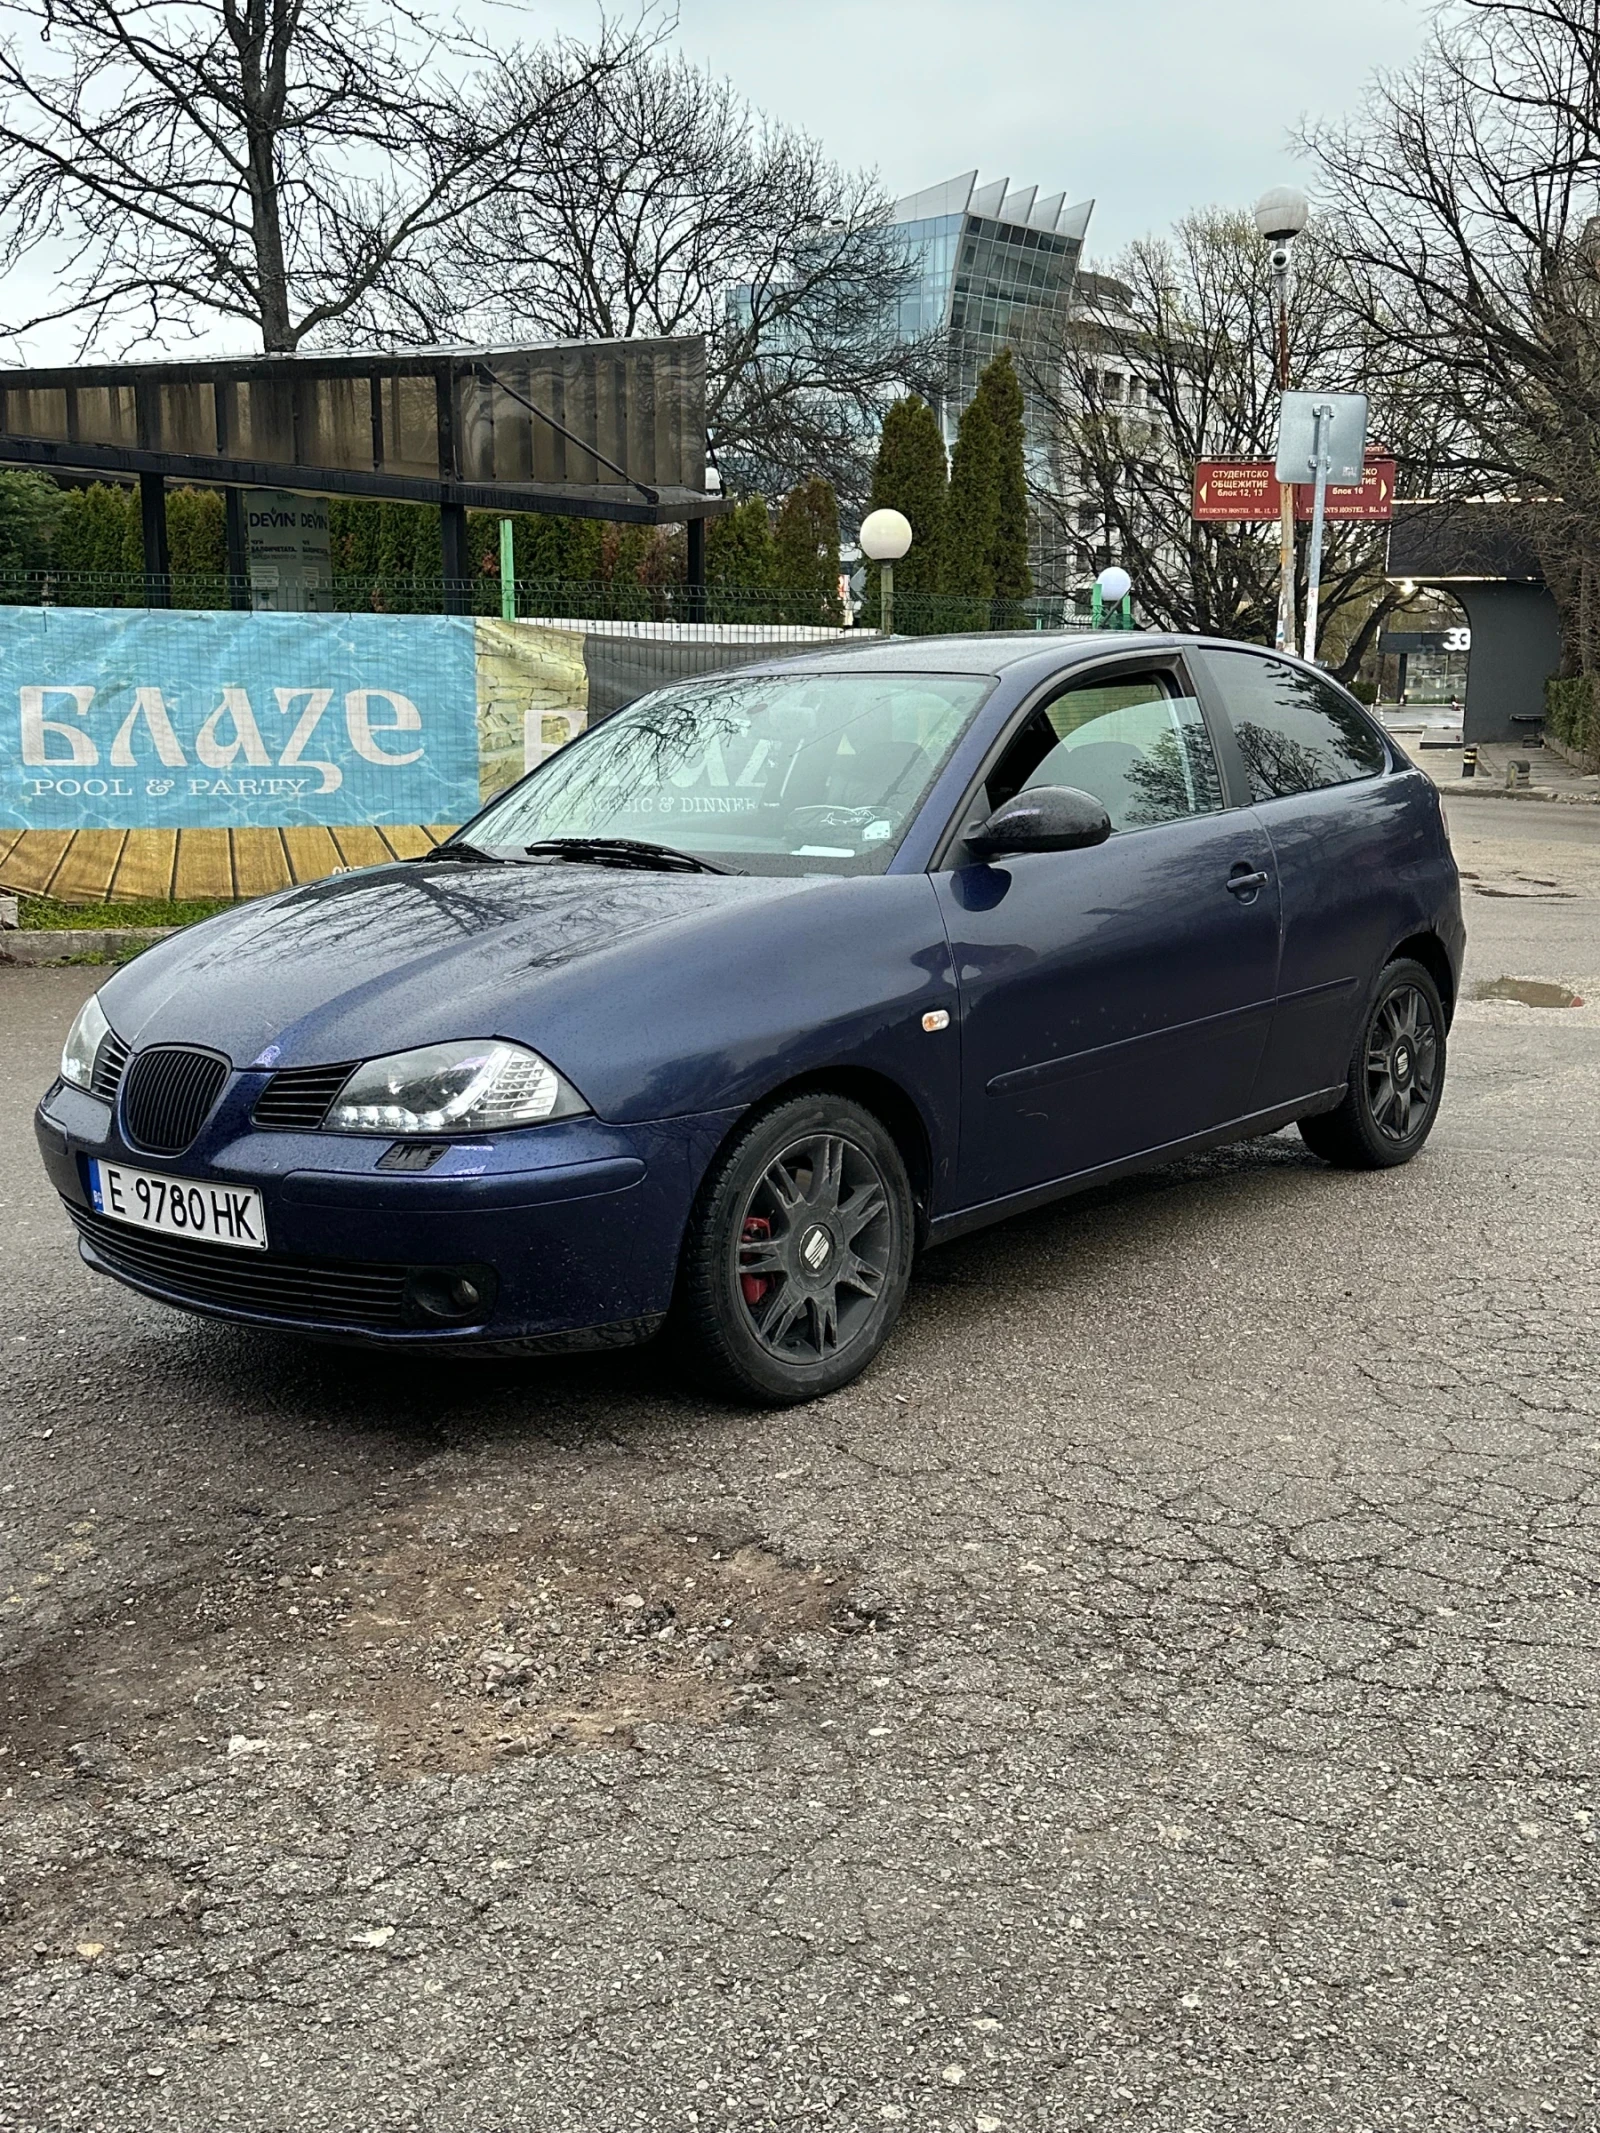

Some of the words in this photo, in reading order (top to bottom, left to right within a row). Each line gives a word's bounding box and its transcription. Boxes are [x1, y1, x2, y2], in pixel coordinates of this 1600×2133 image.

[1212, 470, 1269, 479] СТУДЕНТСКО
[1211, 480, 1269, 489] ОБЩЕЖИТИЕ
[1332, 487, 1352, 495] блок
[1354, 487, 1363, 495] 16
[1217, 489, 1237, 497] блок
[1240, 489, 1251, 497] 12,
[1305, 506, 1338, 514] STNTS
[249, 512, 296, 528] DEVIN
[301, 512, 328, 530] DEVIN
[1442, 627, 1471, 651] 33
[30, 778, 133, 796] POOL
[147, 778, 175, 796] &
[188, 778, 310, 796] PARTY
[659, 796, 675, 813] &
[108, 1169, 126, 1214] E
[135, 1177, 206, 1231] 9780
